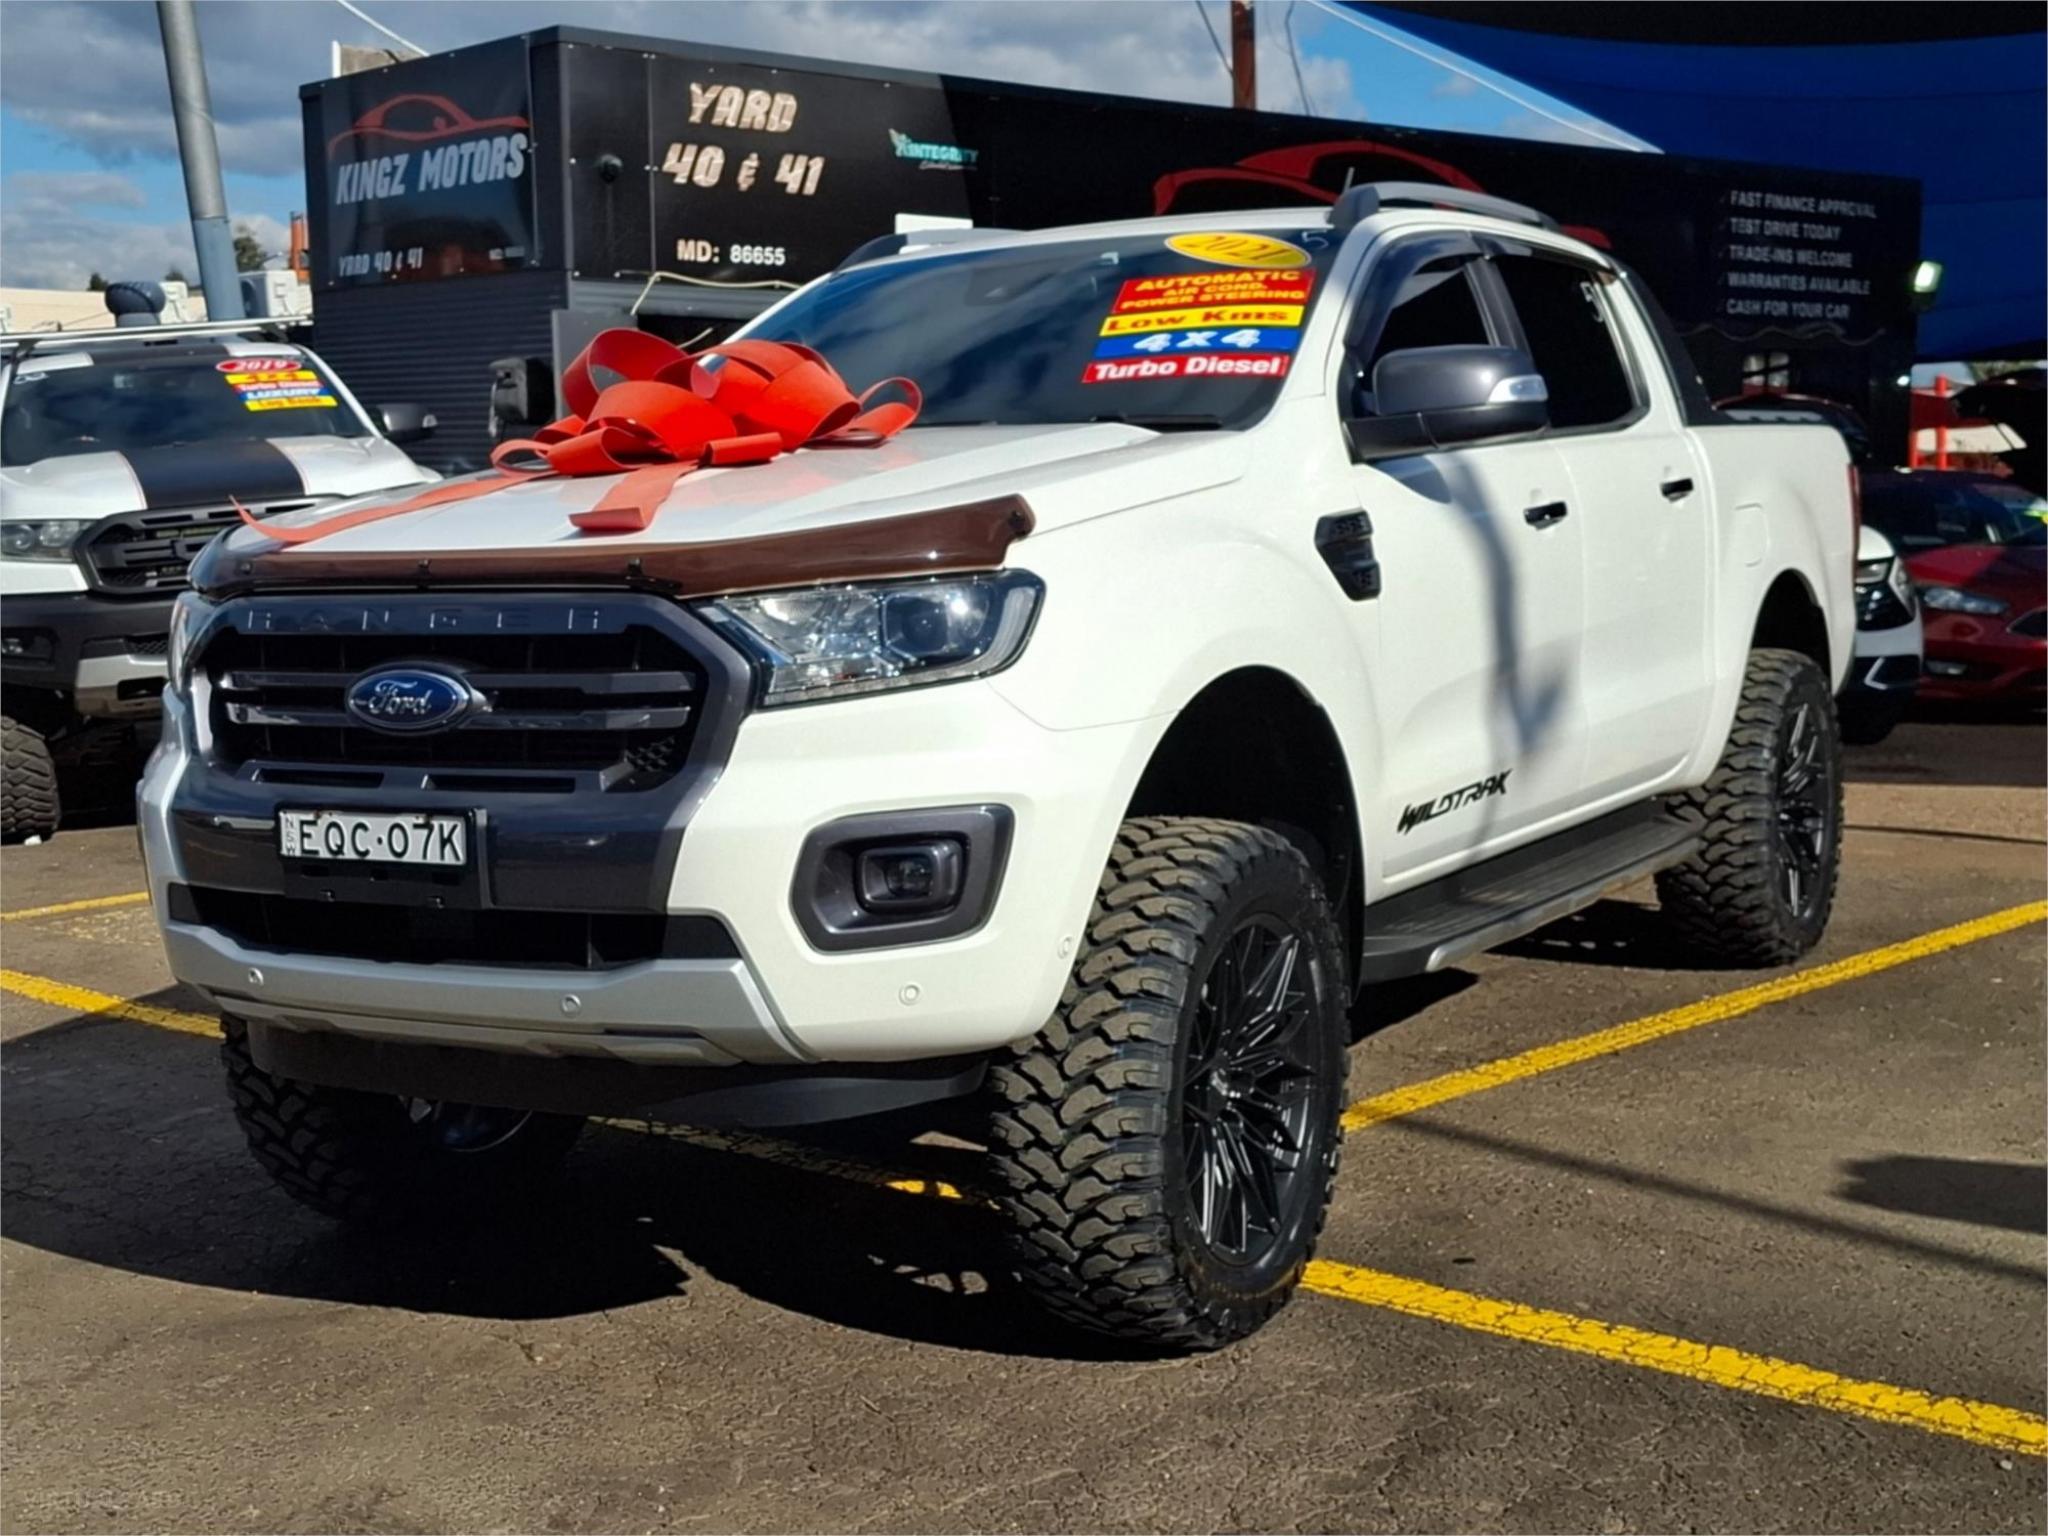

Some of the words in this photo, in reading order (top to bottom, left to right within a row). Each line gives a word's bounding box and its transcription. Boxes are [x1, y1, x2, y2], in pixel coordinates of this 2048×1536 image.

[688, 82, 797, 132] YARD
[336, 153, 409, 205] KINGZ
[418, 132, 528, 192] MOTORS
[662, 142, 725, 187] 40
[775, 153, 825, 195] 41
[1731, 190, 1762, 208] FAST
[1764, 193, 1815, 213] FINANCE
[1818, 198, 1877, 219] APPROVAL
[1731, 217, 1761, 235] TEST
[1764, 220, 1800, 238] DRIVE
[1802, 223, 1840, 240] TODAY
[374, 251, 392, 272] 40
[408, 247, 423, 268] 41
[676, 239, 720, 263] MD:
[730, 244, 786, 266] 86655
[1729, 245, 1794, 264] TRADE-INS
[1795, 249, 1852, 268] WELCOME
[1136, 270, 1299, 292] AUTOMATIC
[1163, 287, 1199, 297] AIR
[1728, 272, 1806, 292] WARRANTIES
[1809, 275, 1871, 295] AVAILABLE
[1121, 297, 1194, 309] POWER
[1199, 290, 1305, 302] STEERING
[1727, 299, 1761, 316] CASH
[1764, 300, 1788, 317] FOR
[1791, 302, 1822, 318] YOUR
[1825, 303, 1849, 319] CAR
[1096, 359, 1178, 380] Turbo
[1184, 356, 1281, 374] Diesel
[368, 679, 432, 714] Ford
[1397, 769, 1513, 835] WILDTRAK
